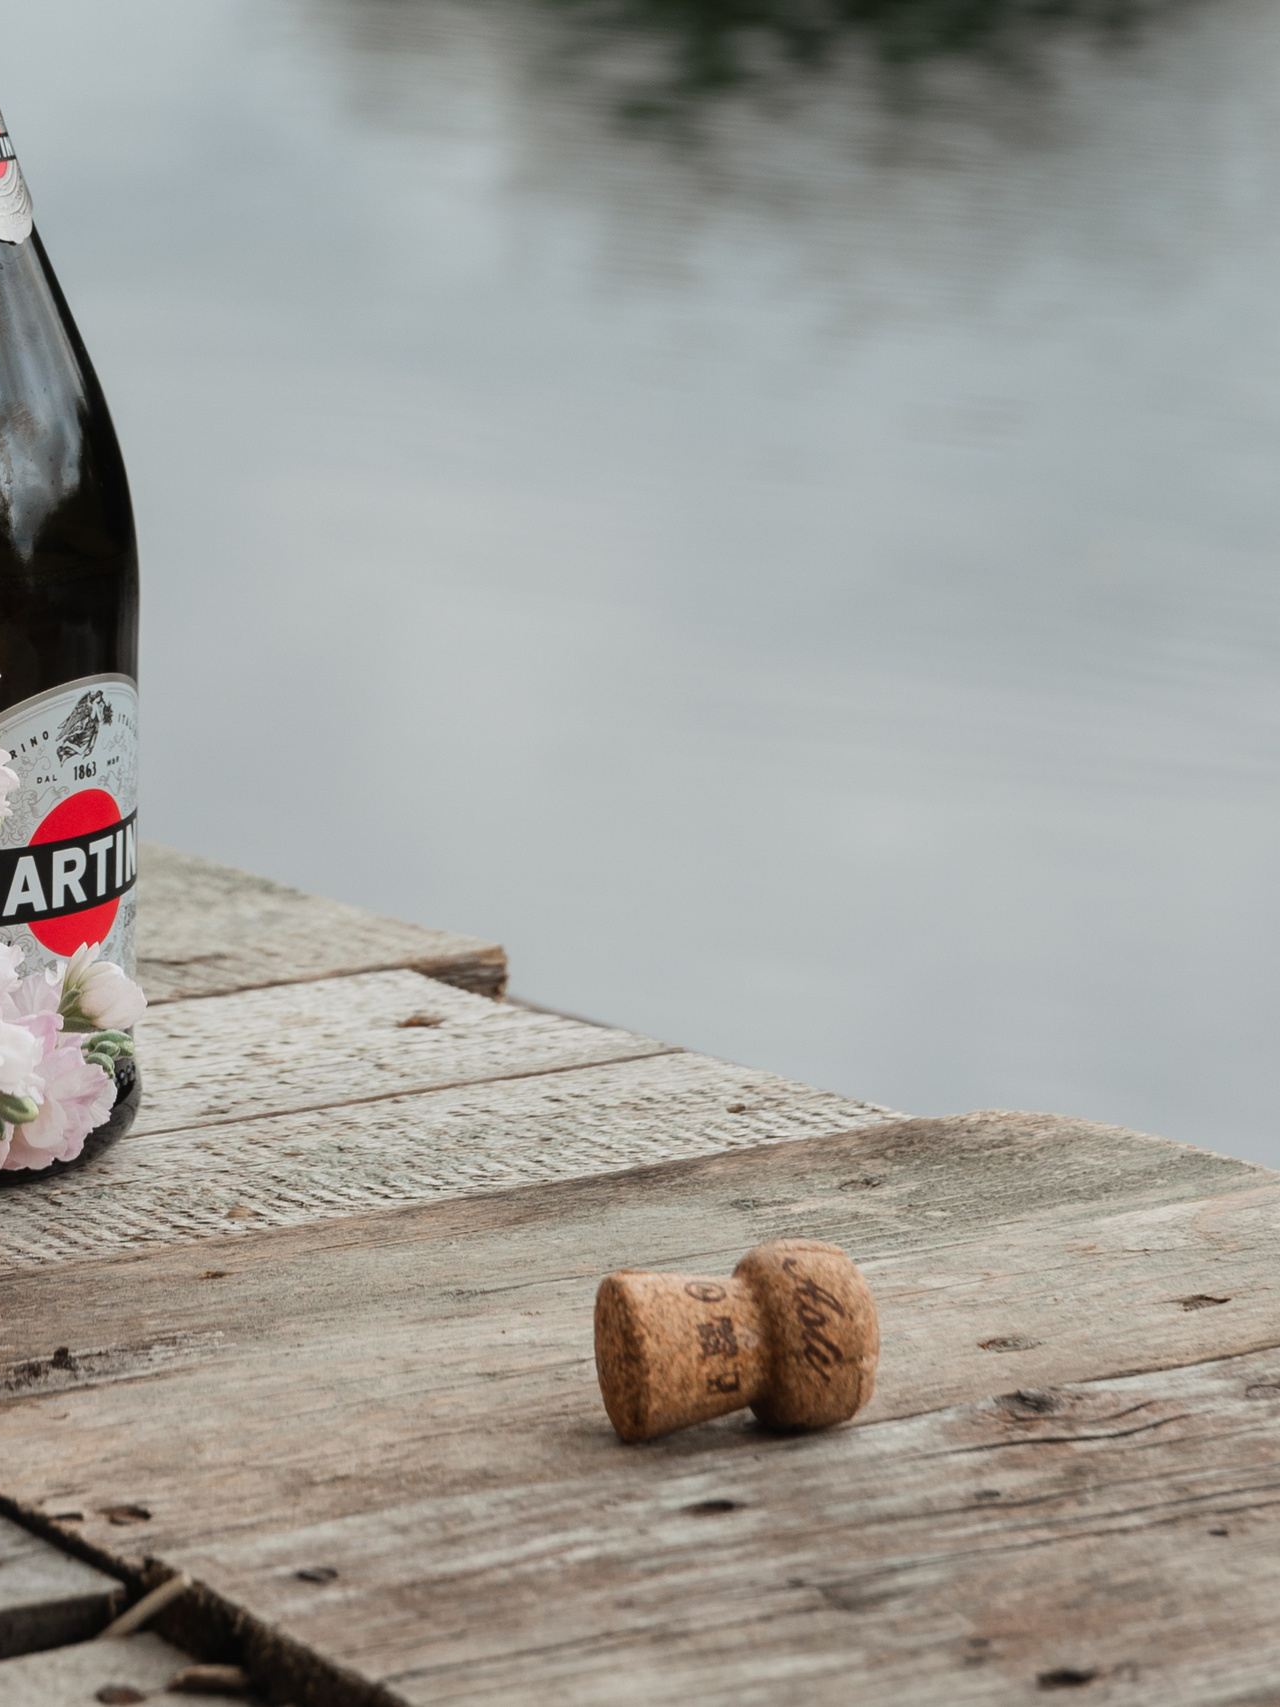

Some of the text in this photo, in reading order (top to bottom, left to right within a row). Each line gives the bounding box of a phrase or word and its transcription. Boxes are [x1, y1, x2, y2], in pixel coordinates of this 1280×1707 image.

[9, 730, 49, 760] RINO
[36, 774, 58, 784] DAL
[74, 760, 97, 781] 1863
